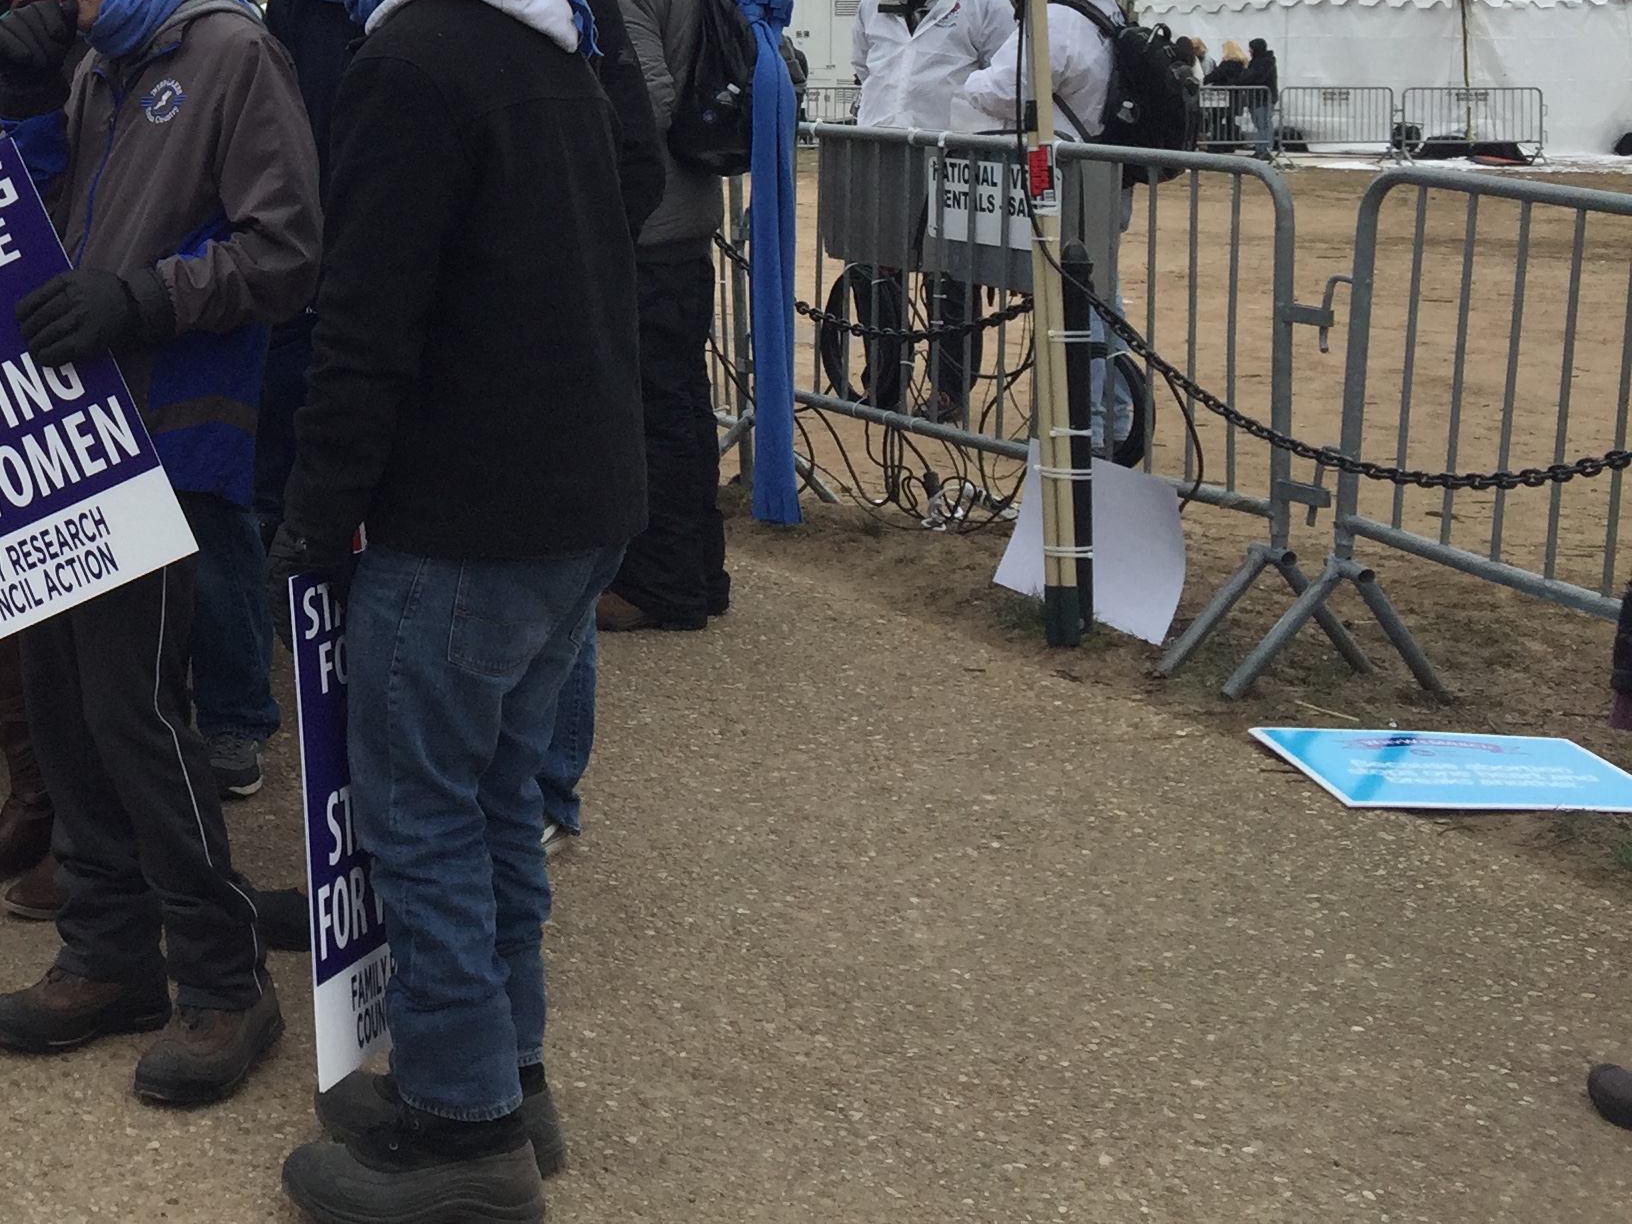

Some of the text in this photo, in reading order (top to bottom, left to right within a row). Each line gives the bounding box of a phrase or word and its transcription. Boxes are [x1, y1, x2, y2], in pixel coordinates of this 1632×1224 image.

[5, 506, 111, 576] RESEARCH
[43, 542, 120, 601] ACTION
[319, 635, 349, 695] FO
[318, 866, 368, 962] FOR
[351, 956, 388, 1012] FAMILY
